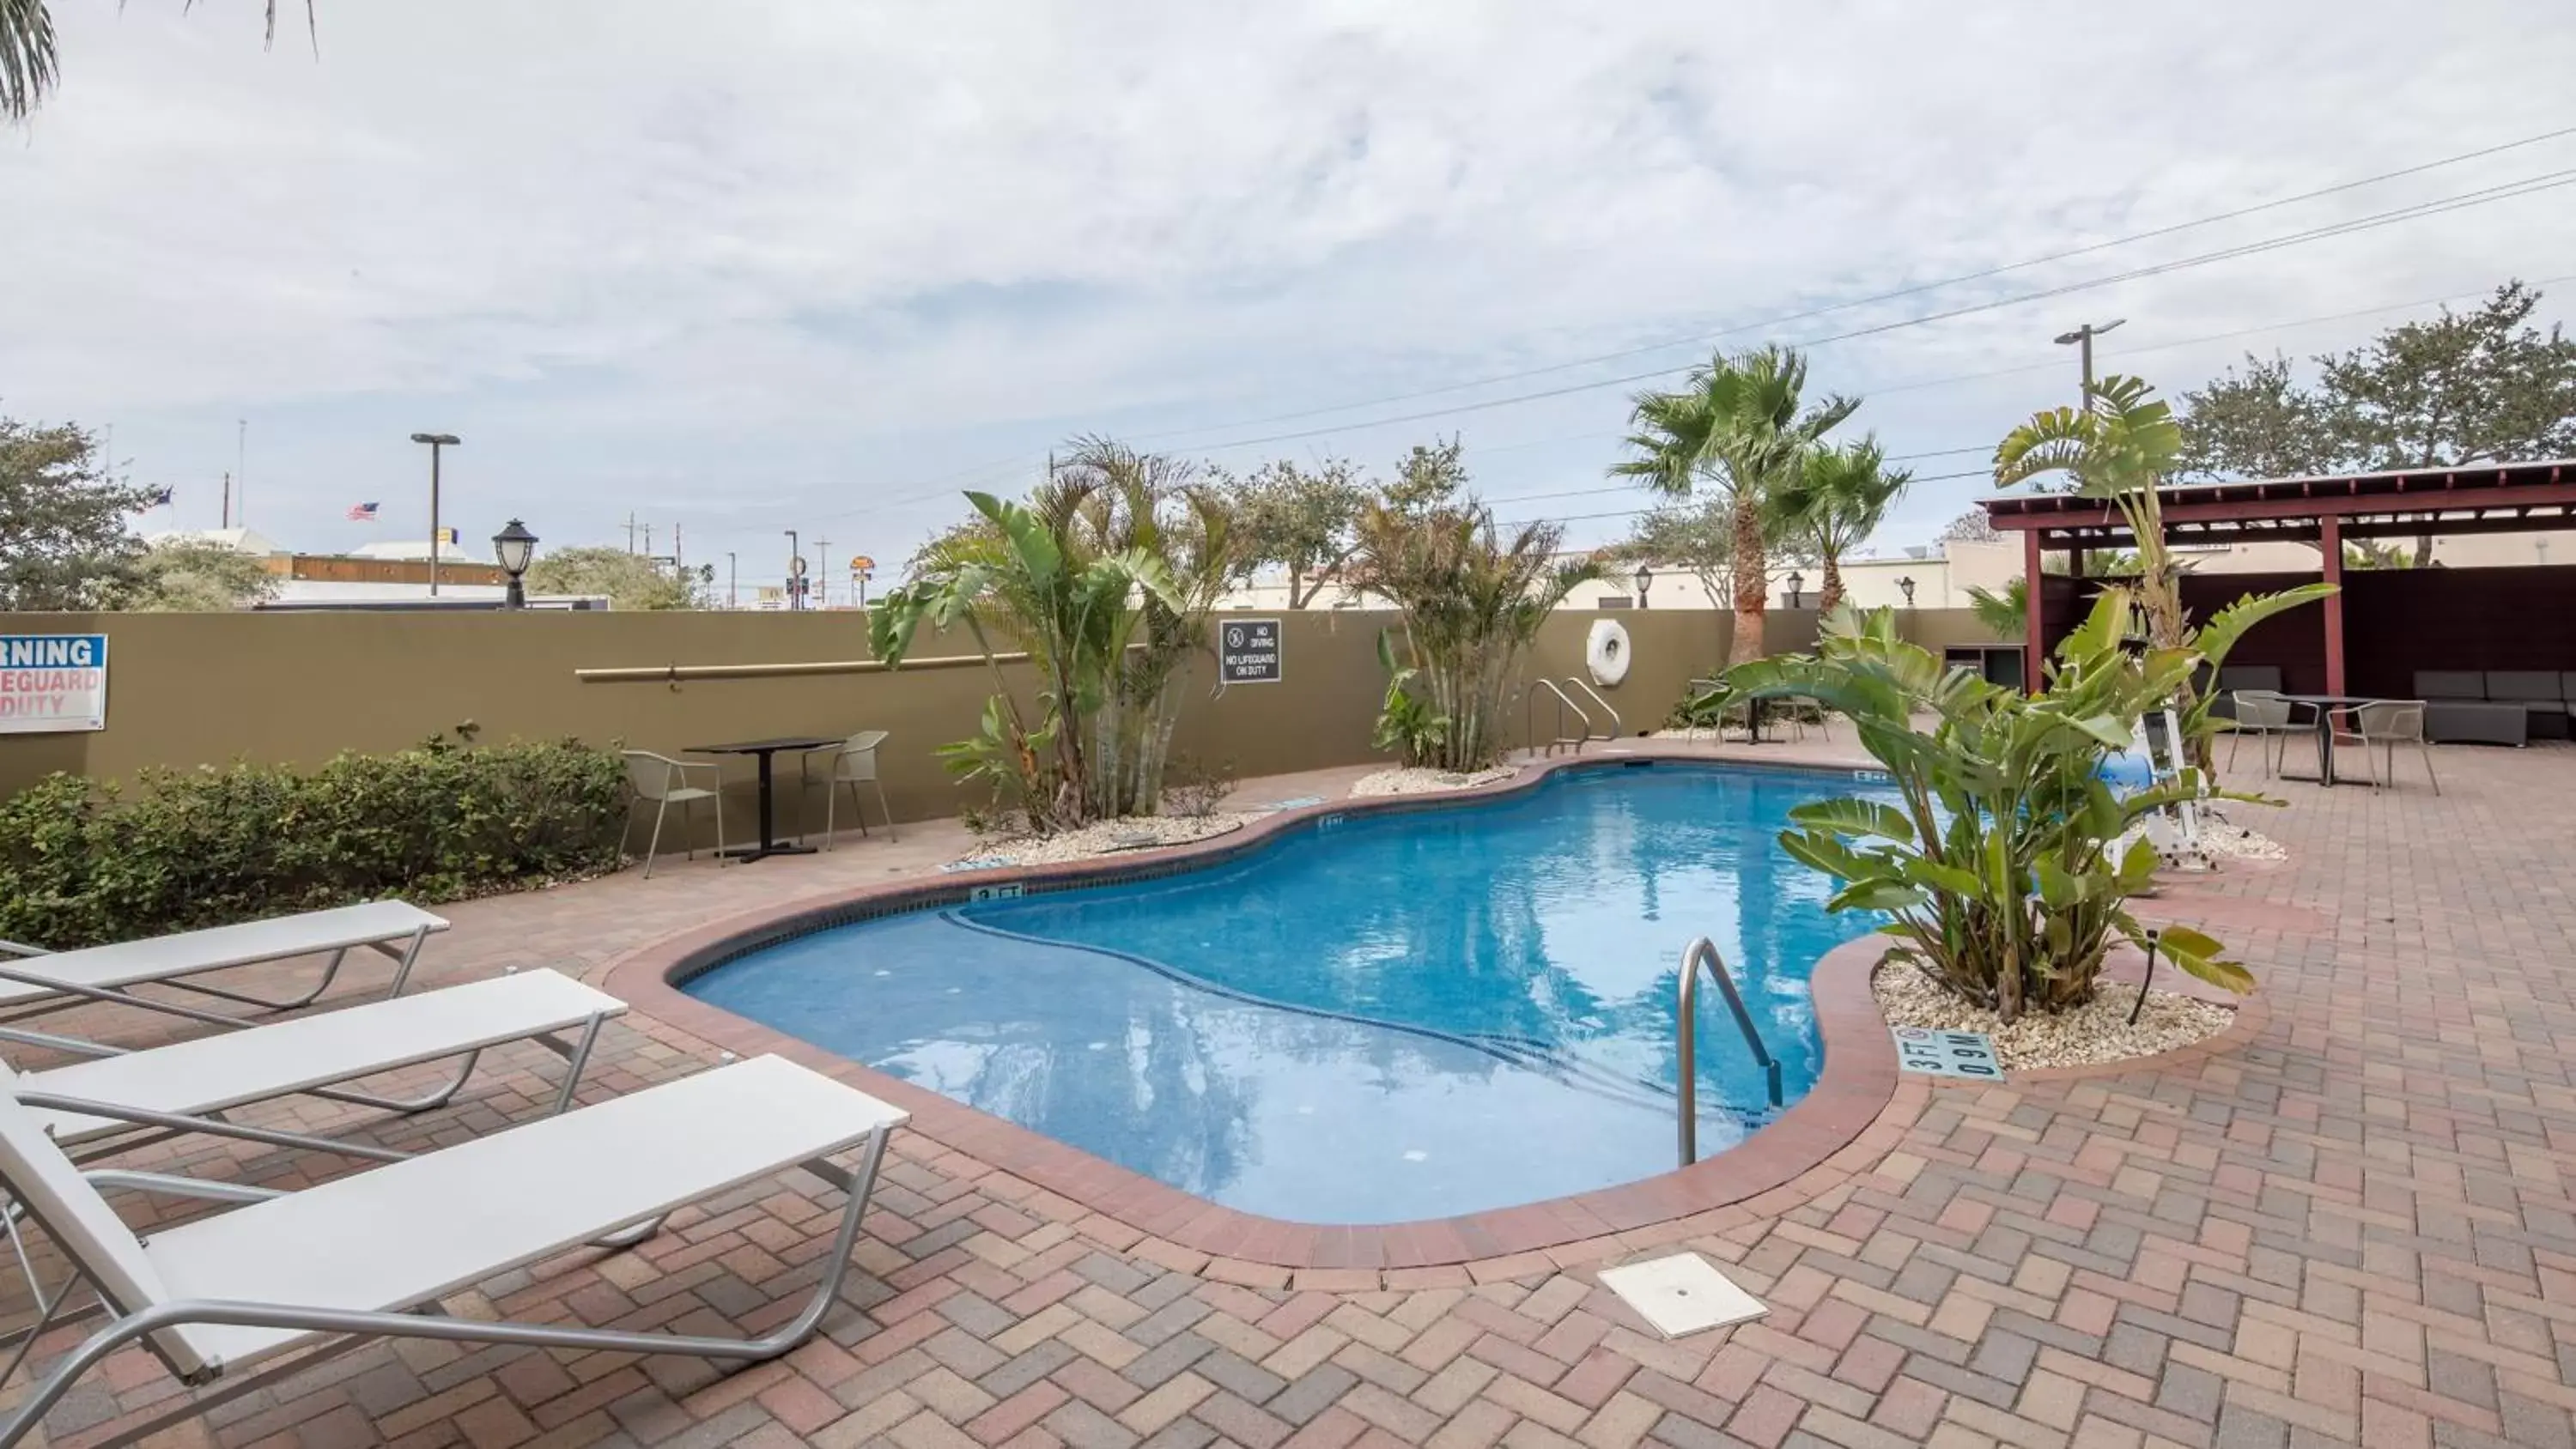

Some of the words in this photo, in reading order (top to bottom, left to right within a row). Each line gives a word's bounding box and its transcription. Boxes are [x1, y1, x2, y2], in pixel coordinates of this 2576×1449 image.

[1256, 625, 1268, 636] NO
[1226, 655, 1236, 665] NO
[1238, 653, 1276, 665] LIFEGUARD
[1236, 665, 1247, 676] ON
[1248, 665, 1267, 676] DUTY
[0, 694, 65, 717] DUTY
[1903, 1041, 1941, 1058] FT
[1907, 1059, 1942, 1070] 3
